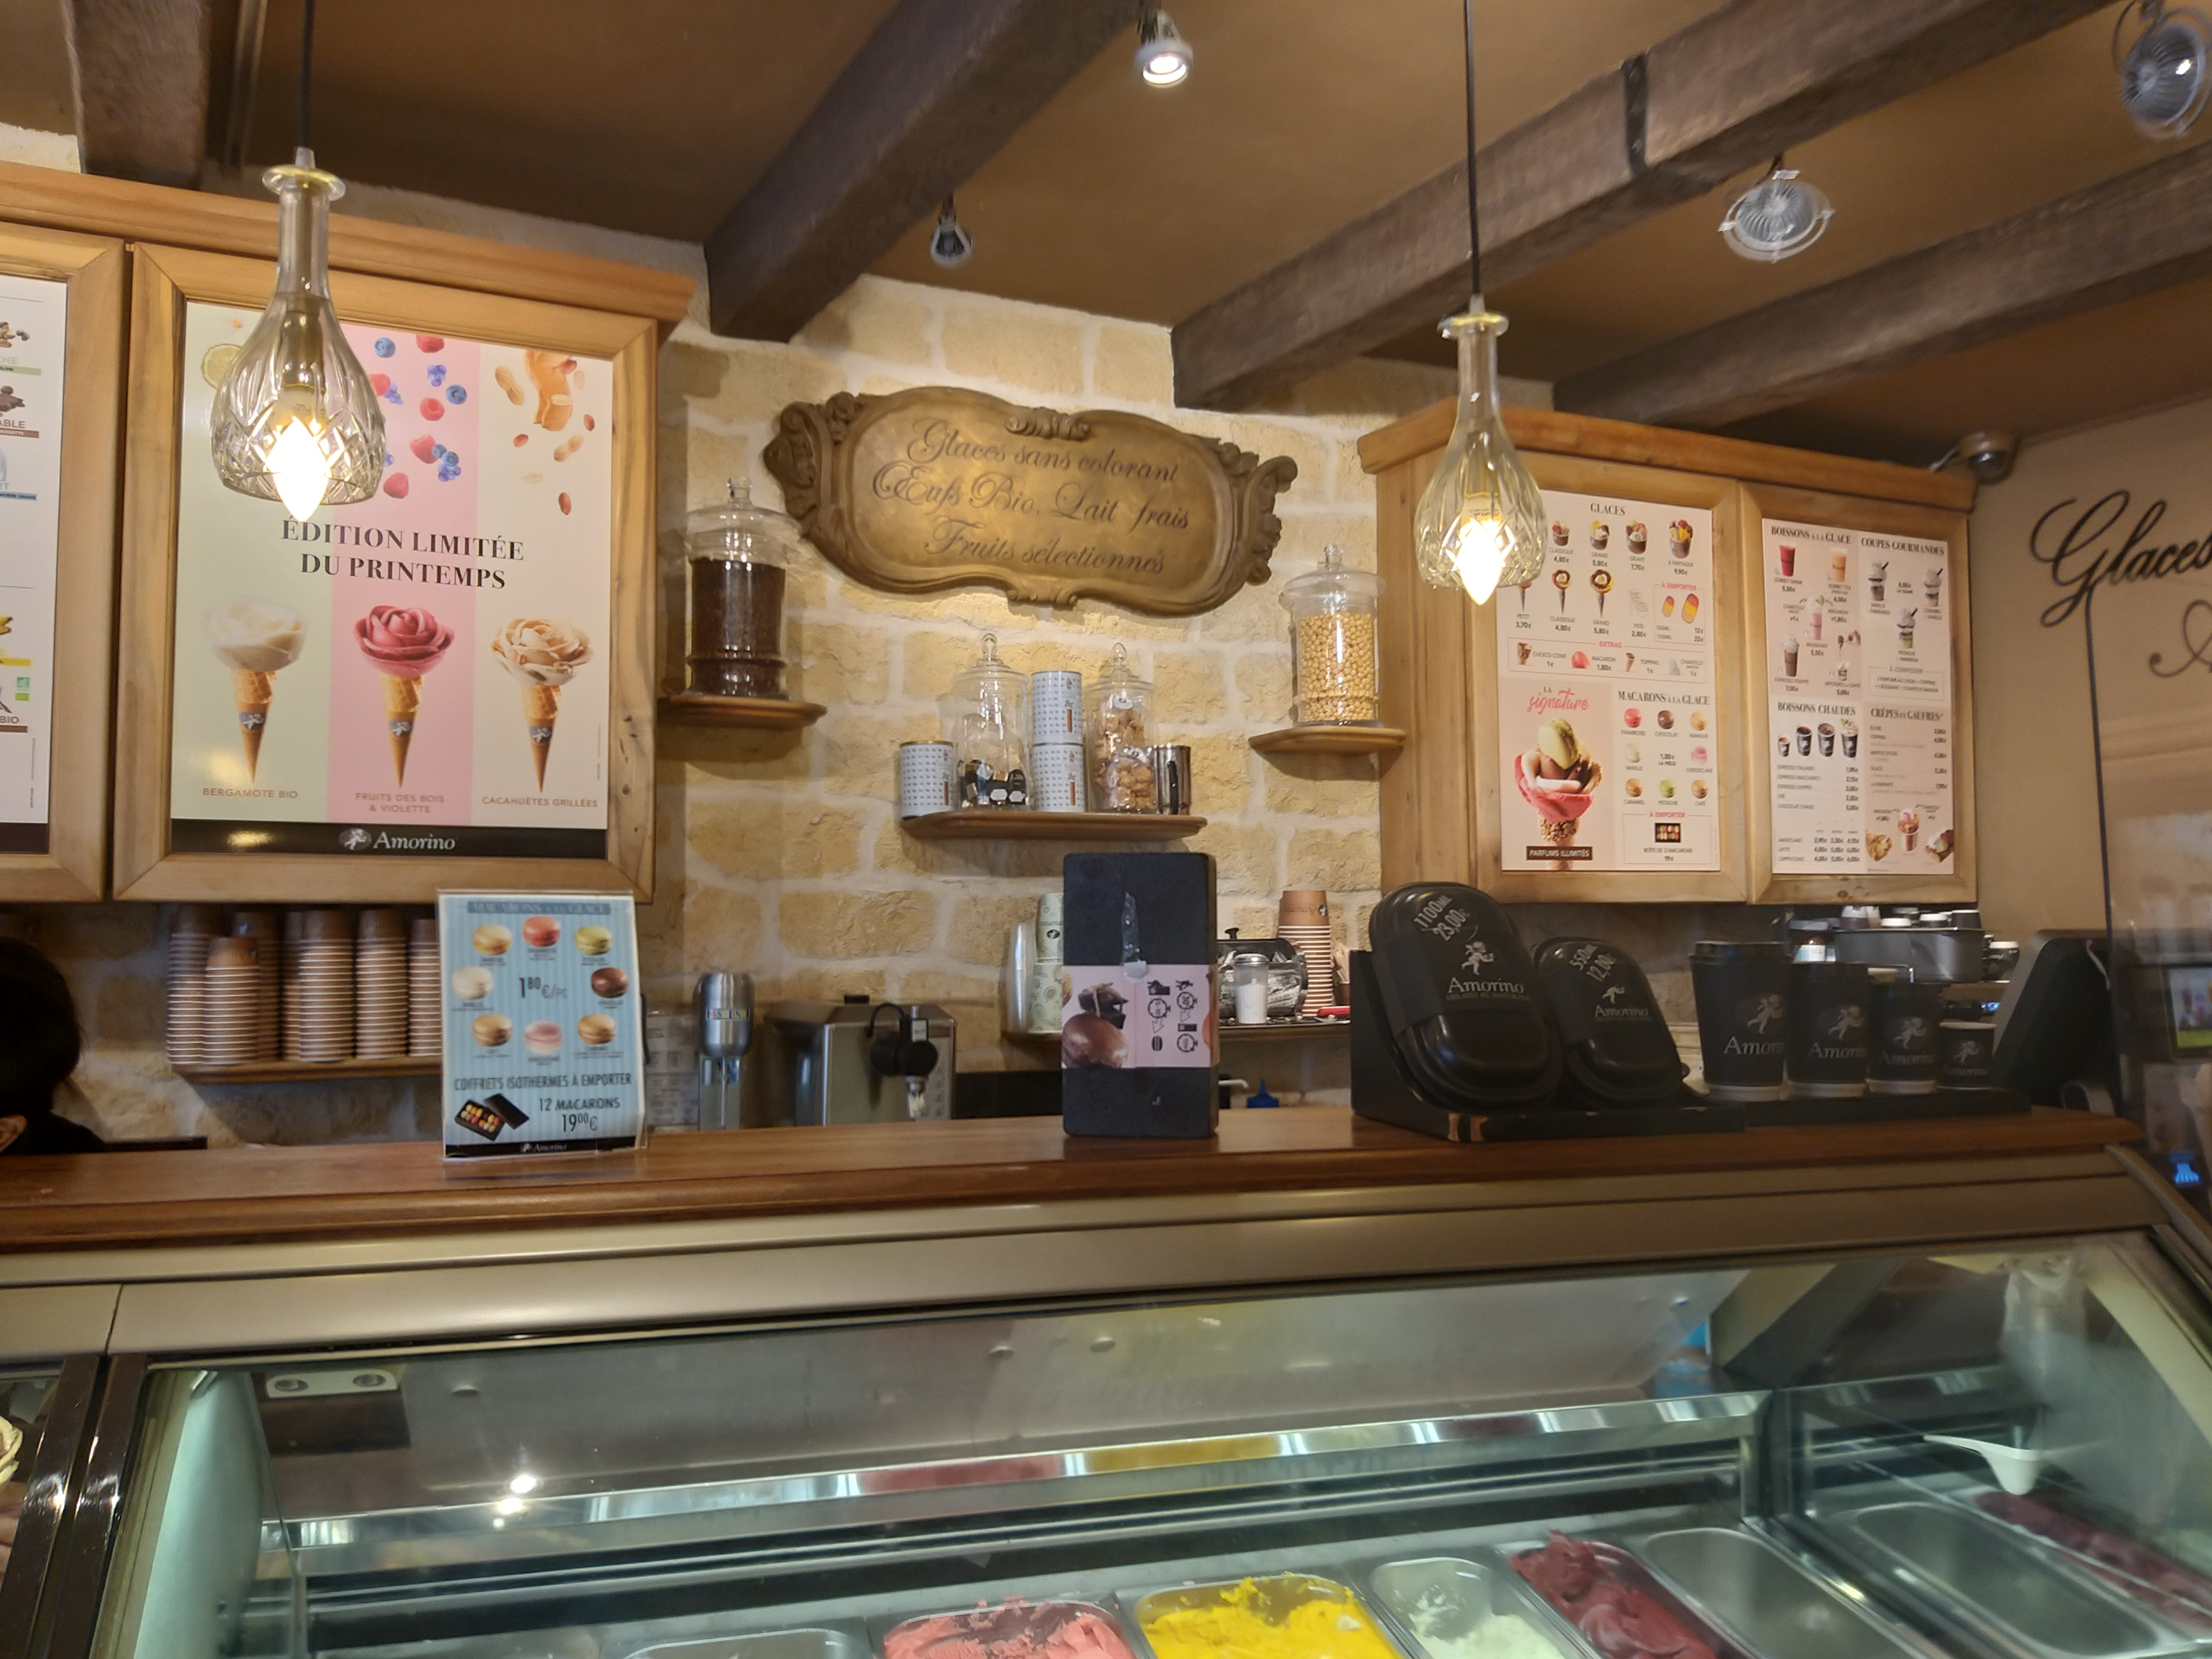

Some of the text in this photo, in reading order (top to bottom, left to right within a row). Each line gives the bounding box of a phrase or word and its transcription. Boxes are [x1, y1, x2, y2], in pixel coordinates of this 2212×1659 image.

[907, 417, 1178, 481] Glaces sans colorant
[1049, 482, 1118, 522] Lait
[1127, 497, 1188, 534] frais
[1590, 503, 1625, 516] GLACES
[281, 516, 524, 561] ÉDITION LIMITÉE
[1771, 526, 1809, 539] BOISSONS
[1826, 533, 1851, 544] GLACE
[924, 516, 1165, 574] Fruits sélectionnés
[1861, 537, 1944, 555] COUPES GOURMANDES
[300, 553, 505, 589] DU PRINTEMPS
[1526, 688, 1590, 715] signature
[1618, 691, 1666, 703] MACARONS
[1682, 695, 1710, 705] GLACE
[1778, 702, 1856, 715] BOISSONS CHAUDES
[203, 788, 298, 799] BERGAMOTE BIO
[356, 792, 444, 803] FRUITS DES BOIS
[482, 796, 598, 808] CACAHUÈTES GRILLÉES
[380, 804, 431, 813] VIOLETTE
[373, 831, 455, 850] Amorino
[1449, 977, 1524, 994] Amorino
[454, 1077, 503, 1091] COFFRETS
[581, 1073, 631, 1086] EMPORTER
[539, 1097, 620, 1111] 12 MACARONS
